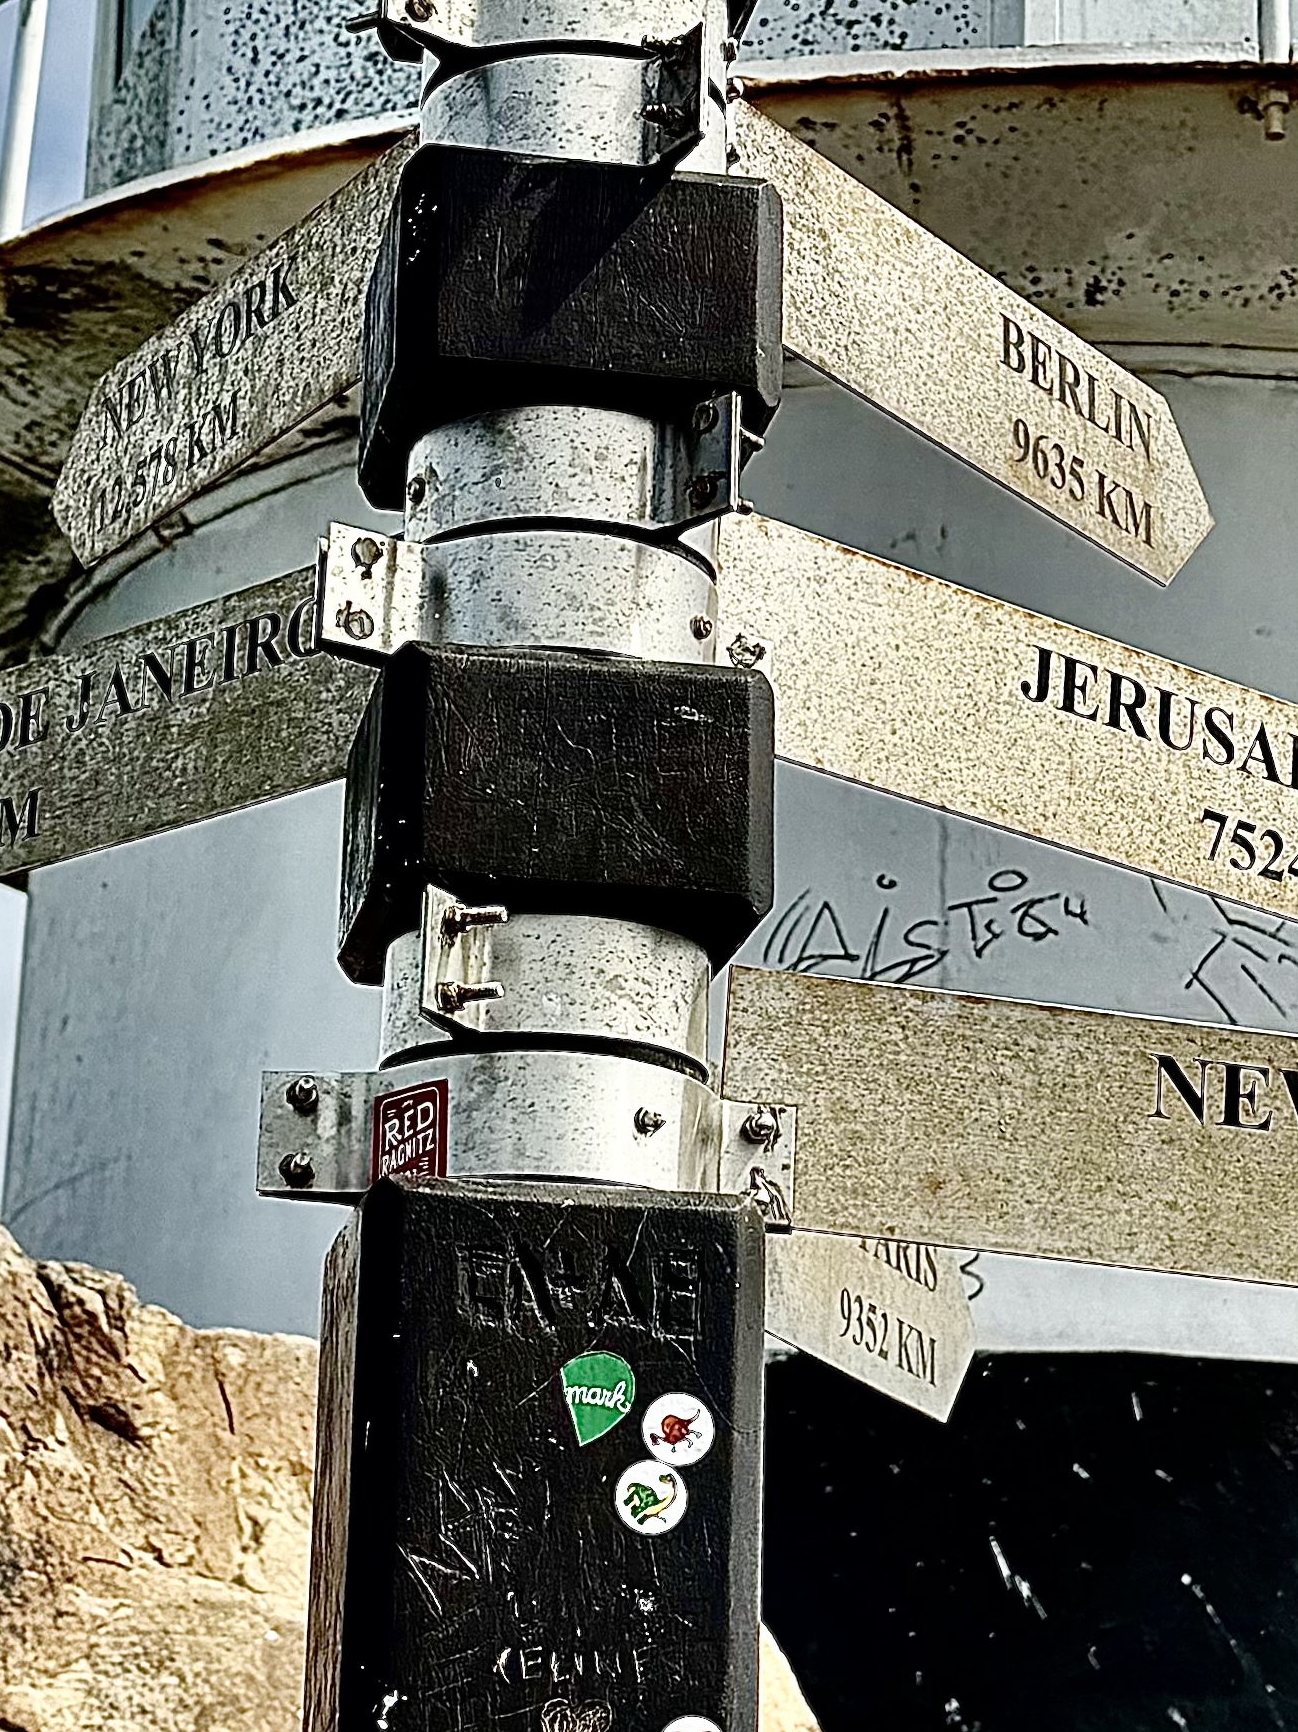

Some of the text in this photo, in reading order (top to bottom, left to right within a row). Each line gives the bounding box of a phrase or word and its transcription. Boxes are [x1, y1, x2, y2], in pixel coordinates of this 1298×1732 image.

[100, 254, 301, 450] NEW YORK
[999, 312, 1153, 464] BERLIN
[185, 388, 241, 471] KM
[1013, 418, 1155, 549] 9635 KM
[384, 1101, 434, 1151] RED
[839, 1287, 937, 1388] 9352 KM
